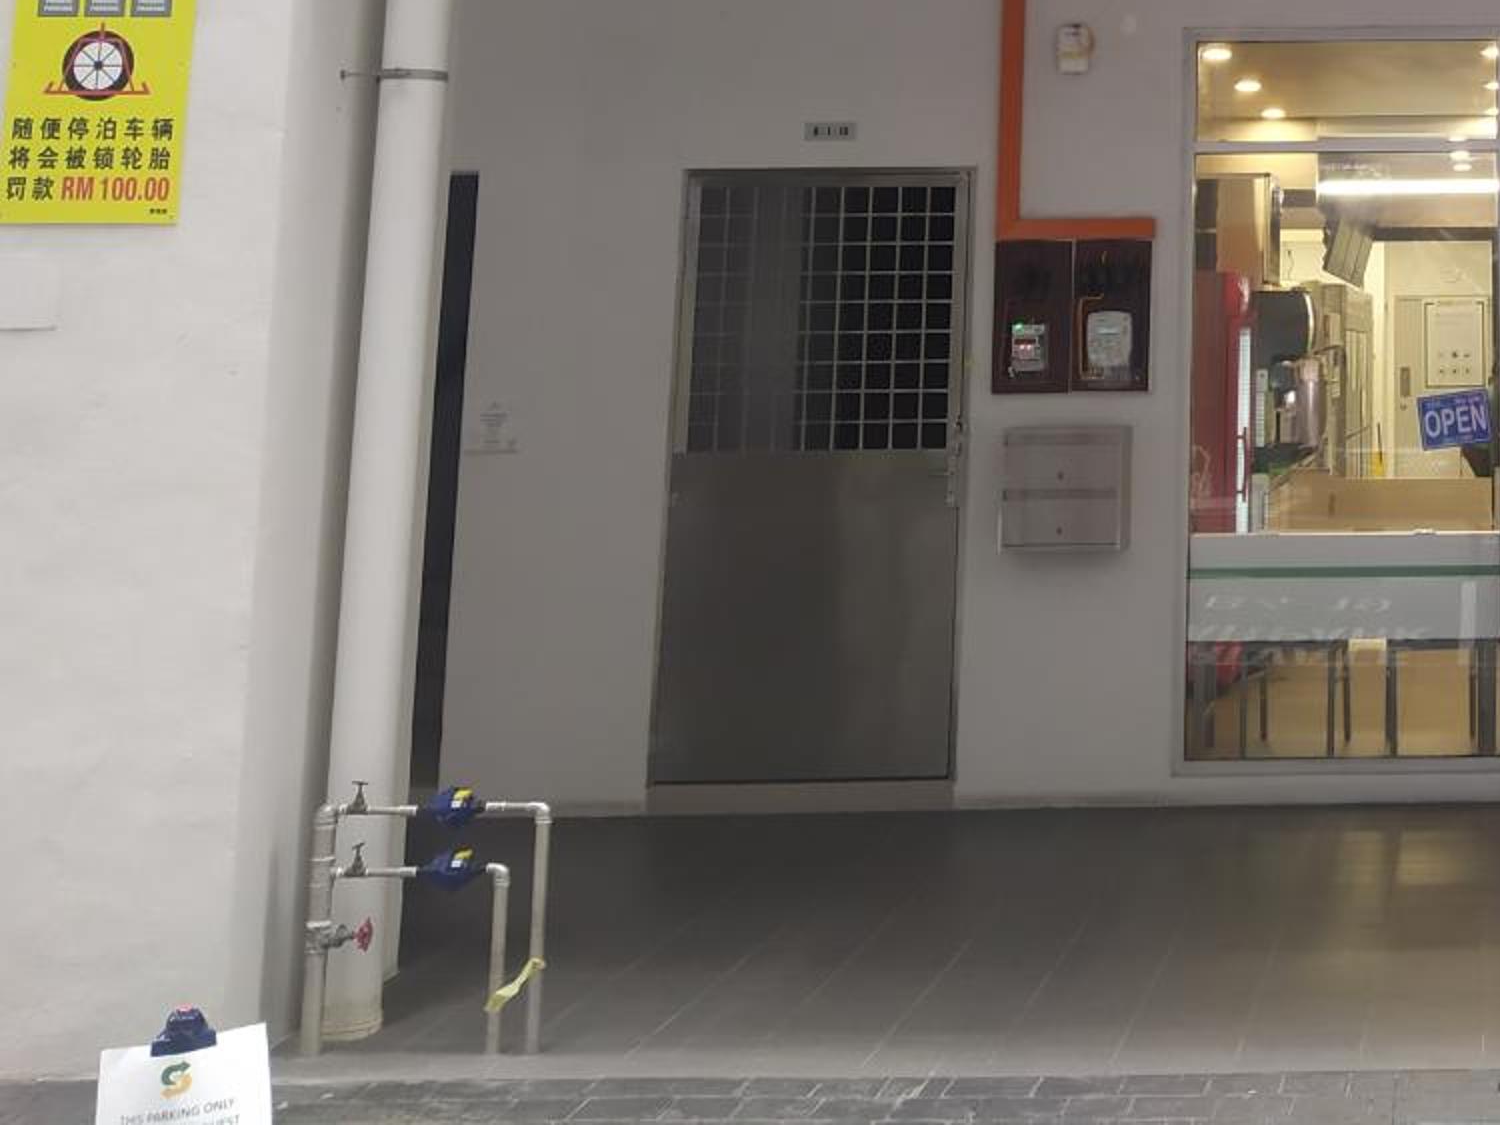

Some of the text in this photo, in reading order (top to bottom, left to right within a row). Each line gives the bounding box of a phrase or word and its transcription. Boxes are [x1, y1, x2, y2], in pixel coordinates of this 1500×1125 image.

[11, 117, 175, 141] 随便停泊车辆
[8, 146, 171, 171] 将会被锁轮胎
[6, 177, 170, 202] 罚款 RM 100.00
[1425, 405, 1487, 437] OPEN
[146, 1106, 201, 1123] PARKING
[203, 1098, 235, 1114] ONLY
